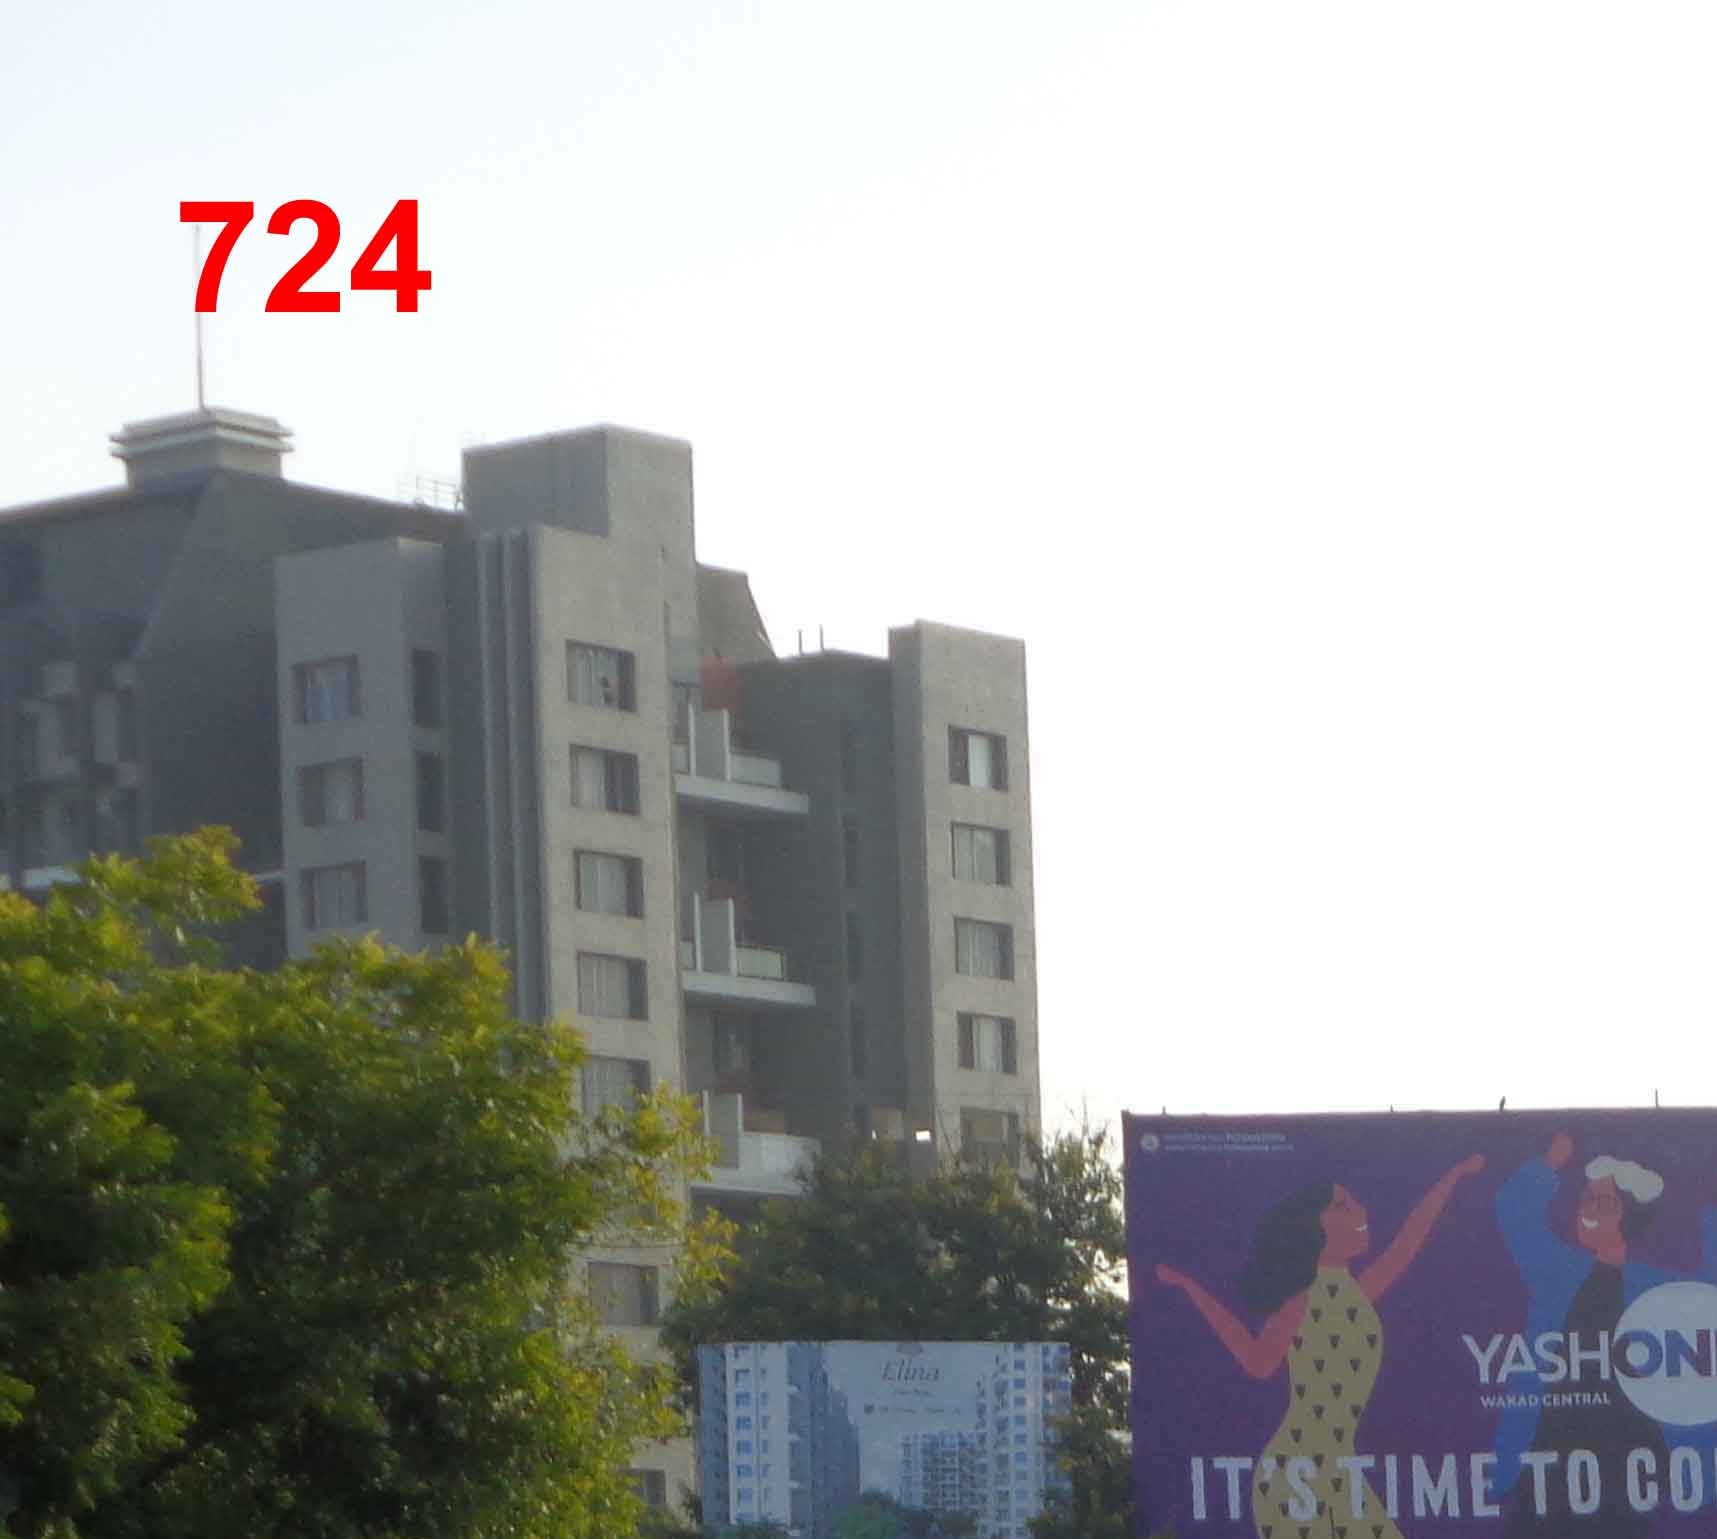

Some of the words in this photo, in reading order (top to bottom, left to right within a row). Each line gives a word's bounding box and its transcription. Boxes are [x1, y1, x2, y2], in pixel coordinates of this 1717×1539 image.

[1480, 1393, 1540, 1409] WAKAD
[1542, 1391, 1612, 1408] CENTRAL
[1190, 1454, 1323, 1522] IT'S
[1335, 1450, 1502, 1520] TIME
[1518, 1448, 1602, 1518] TO
